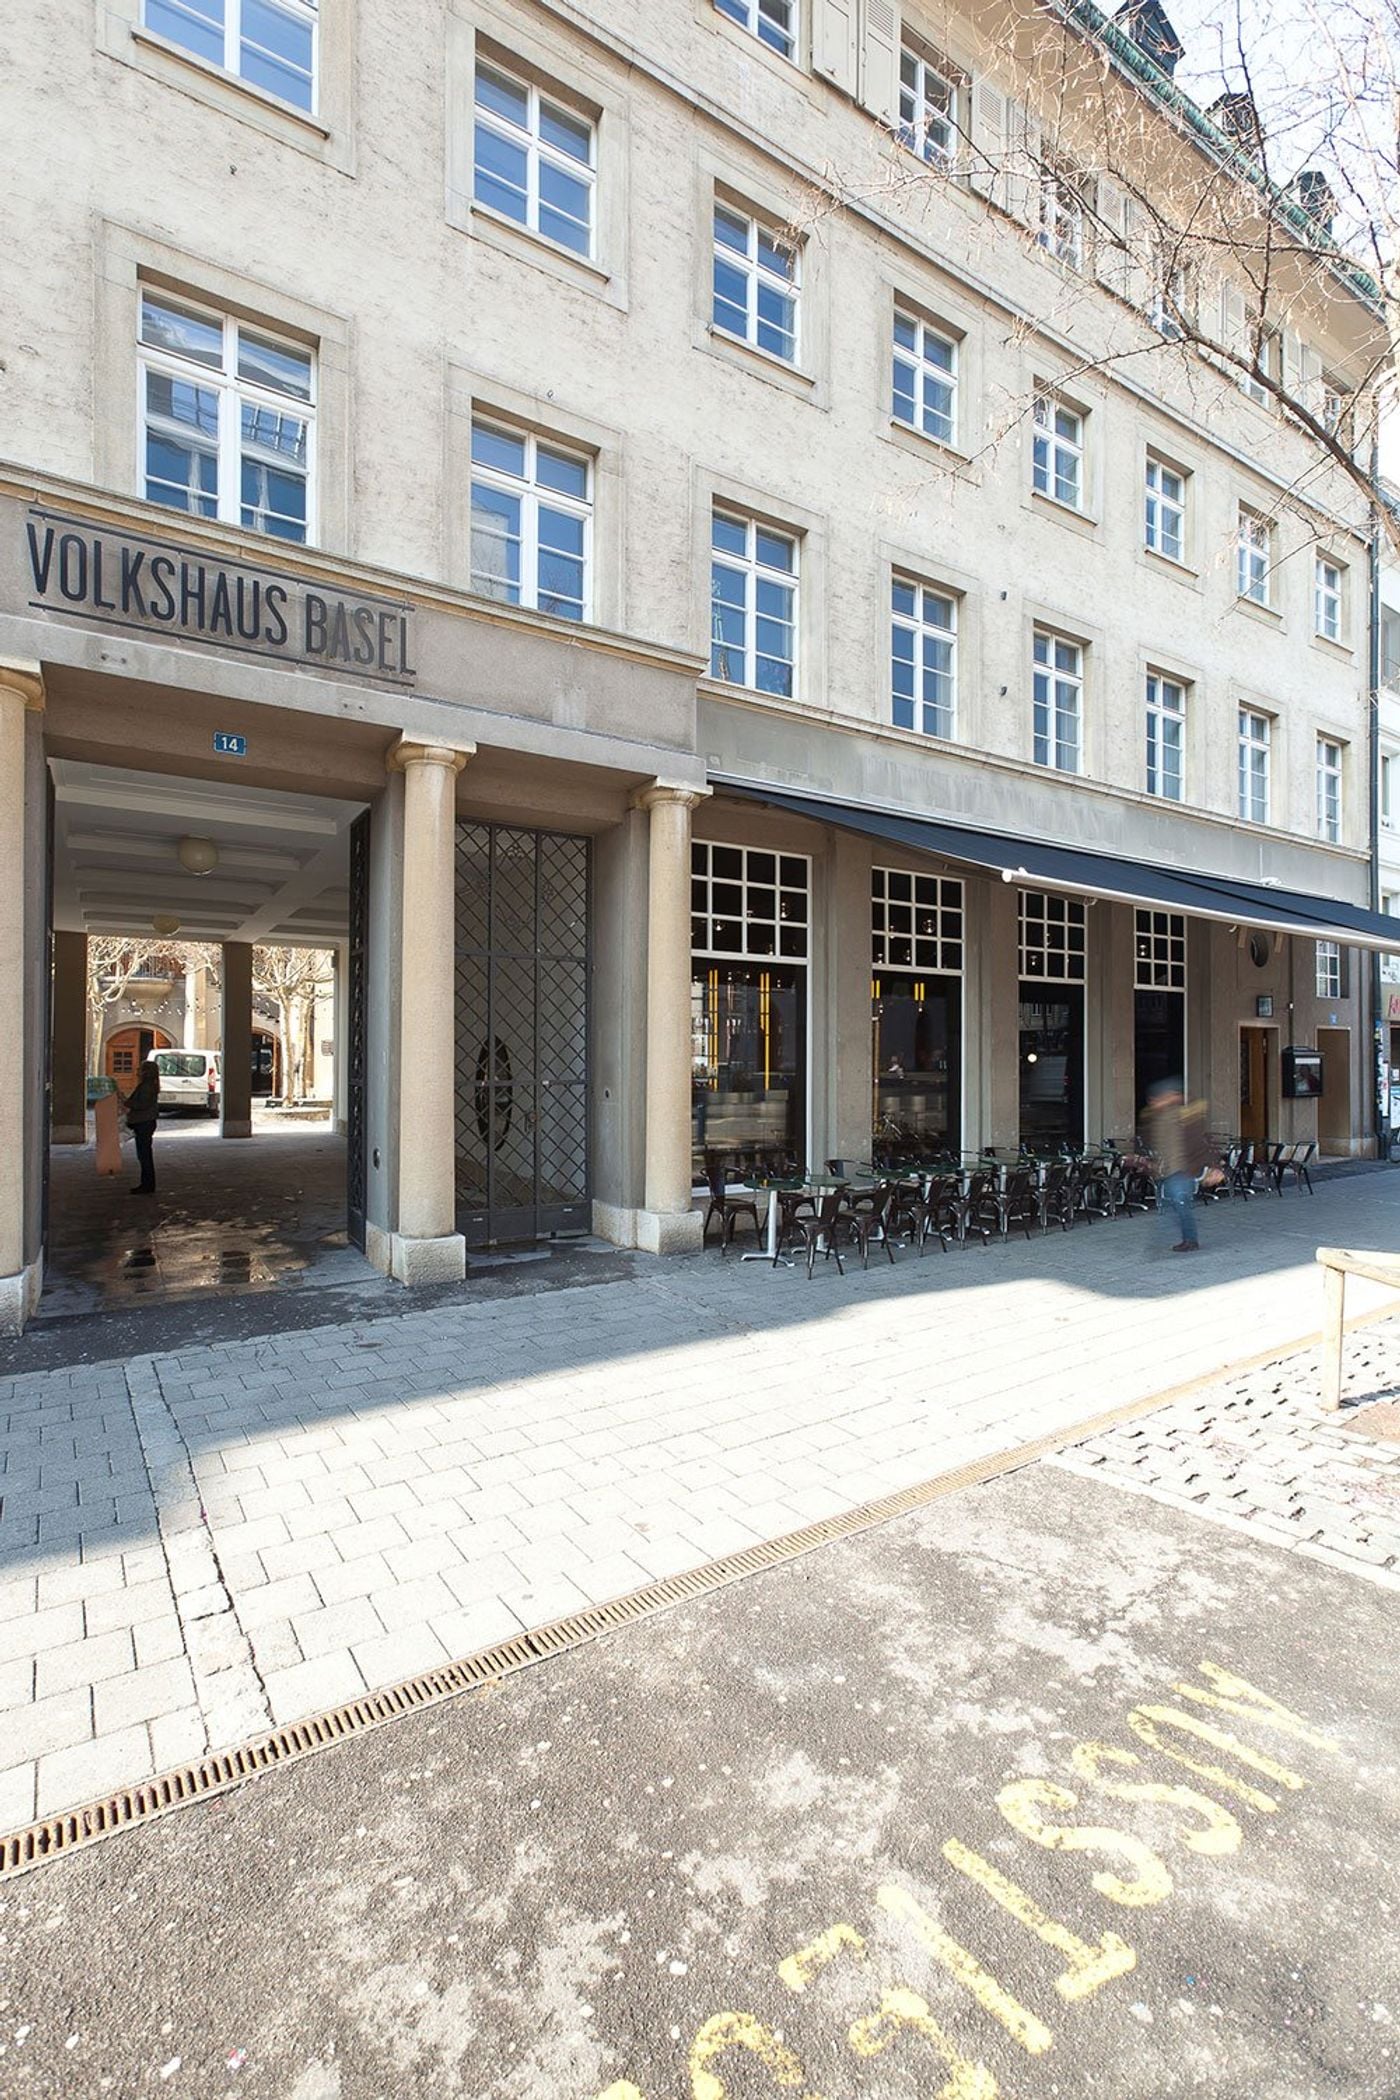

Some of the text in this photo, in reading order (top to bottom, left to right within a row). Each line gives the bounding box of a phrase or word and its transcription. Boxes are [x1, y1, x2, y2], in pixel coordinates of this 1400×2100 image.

[27, 523, 417, 675] VOLKSHAUS BASEL
[221, 736, 238, 751] 14
